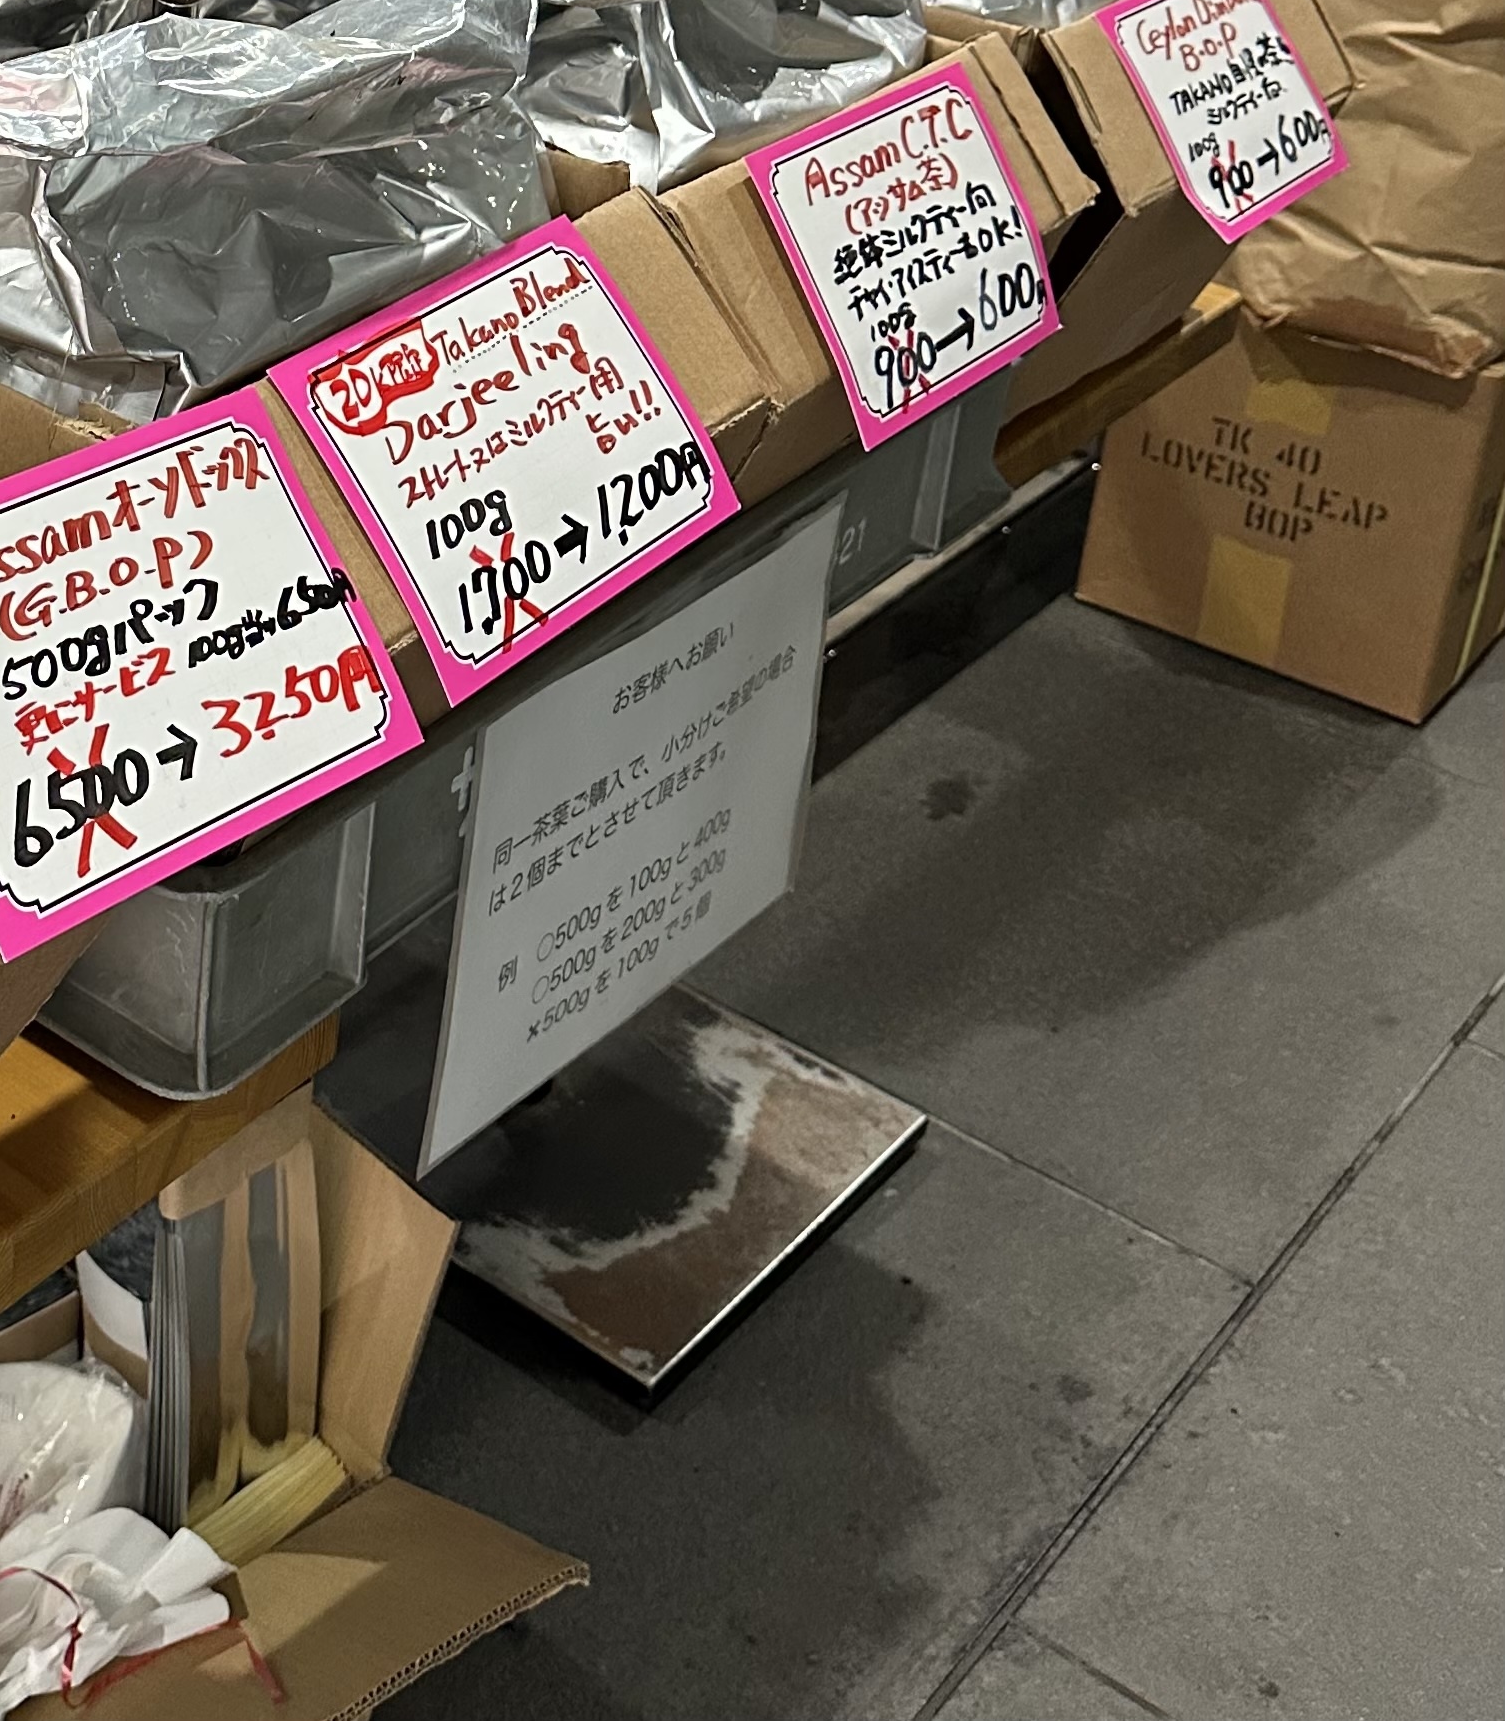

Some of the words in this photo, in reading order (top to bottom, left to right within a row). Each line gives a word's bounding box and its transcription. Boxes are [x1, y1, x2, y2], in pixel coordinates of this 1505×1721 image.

[1208, 159, 1255, 209] 900
[384, 322, 591, 465] Darjeeling
[1140, 430, 1271, 498] LOVERS
[1292, 481, 1389, 531] LEAP
[1211, 416, 1255, 455] TK
[1275, 443, 1323, 476] 40
[425, 488, 514, 560] 100g
[1243, 500, 1315, 543] BOP
[2, 578, 219, 700] 500gパック
[612, 621, 735, 715] お客様へお願い
[498, 955, 519, 993] 例
[606, 885, 623, 913] を
[630, 855, 673, 898] 100g
[694, 808, 732, 849] 400g
[600, 926, 618, 955] を
[620, 895, 667, 943] 200g
[595, 968, 613, 995] を
[617, 936, 661, 979] 100g
